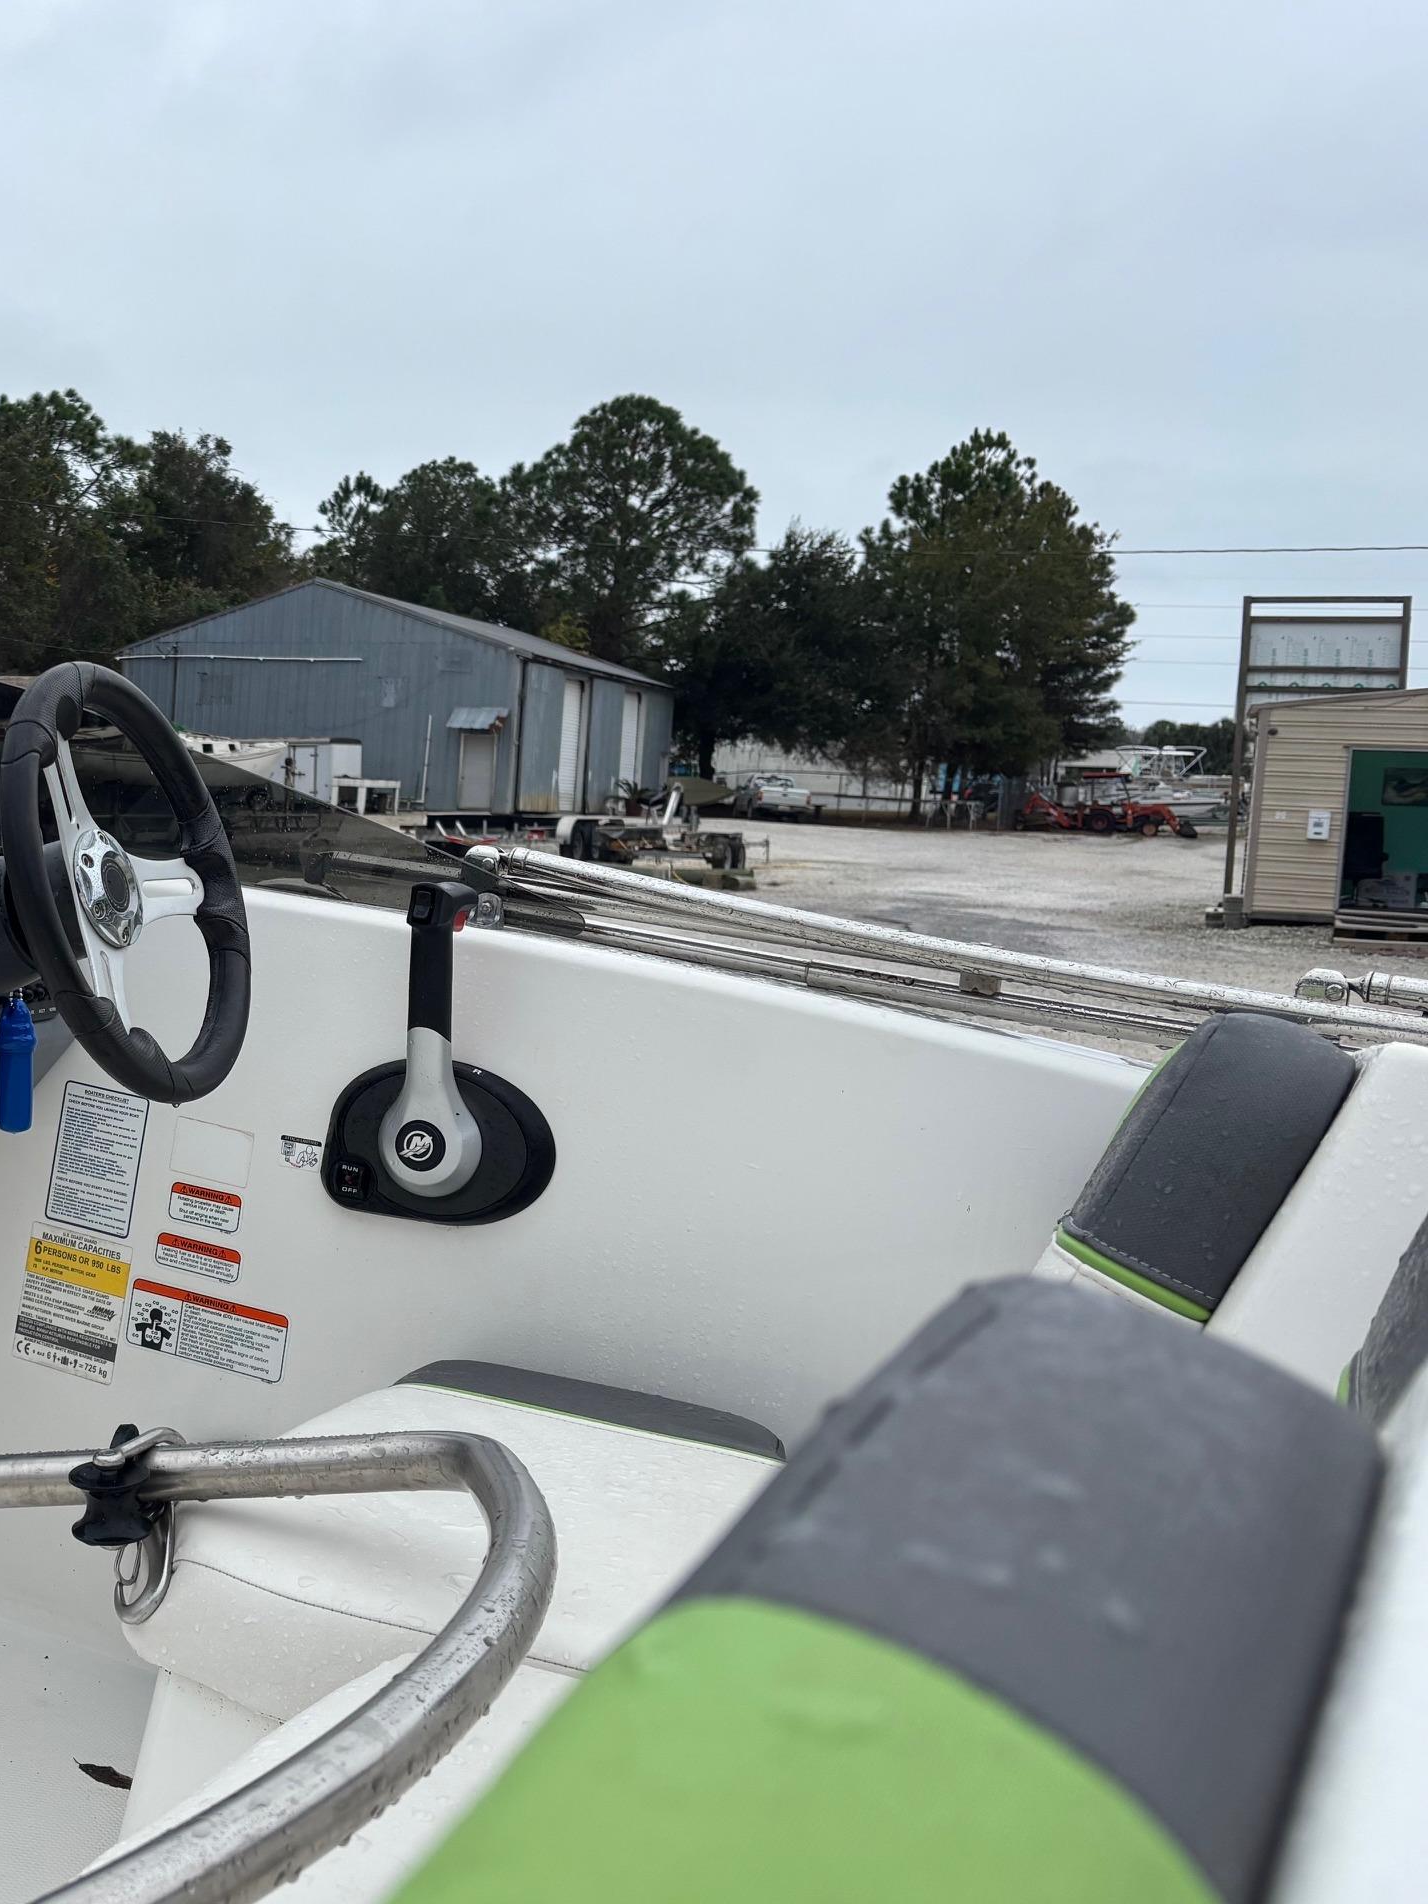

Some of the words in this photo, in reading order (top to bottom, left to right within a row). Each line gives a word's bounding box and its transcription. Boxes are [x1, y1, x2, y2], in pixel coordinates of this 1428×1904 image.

[473, 1068, 483, 1076] R
[106, 1094, 129, 1104] CHECKLIST
[341, 1164, 359, 1173] RUN
[189, 1187, 224, 1201] WARNING
[341, 1186, 358, 1194] OFF
[42, 1232, 77, 1248] MAXIMUM
[77, 1242, 121, 1260] CAPACITIES
[180, 1241, 218, 1255] WARNING
[43, 1246, 77, 1262] PERSONS
[91, 1260, 104, 1269] 950
[106, 1264, 121, 1274] LBS
[193, 1295, 229, 1310] WARNING
[184, 1313, 198, 1321] Engine
[207, 1320, 226, 1328] generator
[202, 1308, 222, 1317] monoxide
[267, 1326, 283, 1334] damage
[16, 1340, 30, 1355] CE
[84, 1363, 97, 1374] 725
[249, 1365, 269, 1375] regarding
